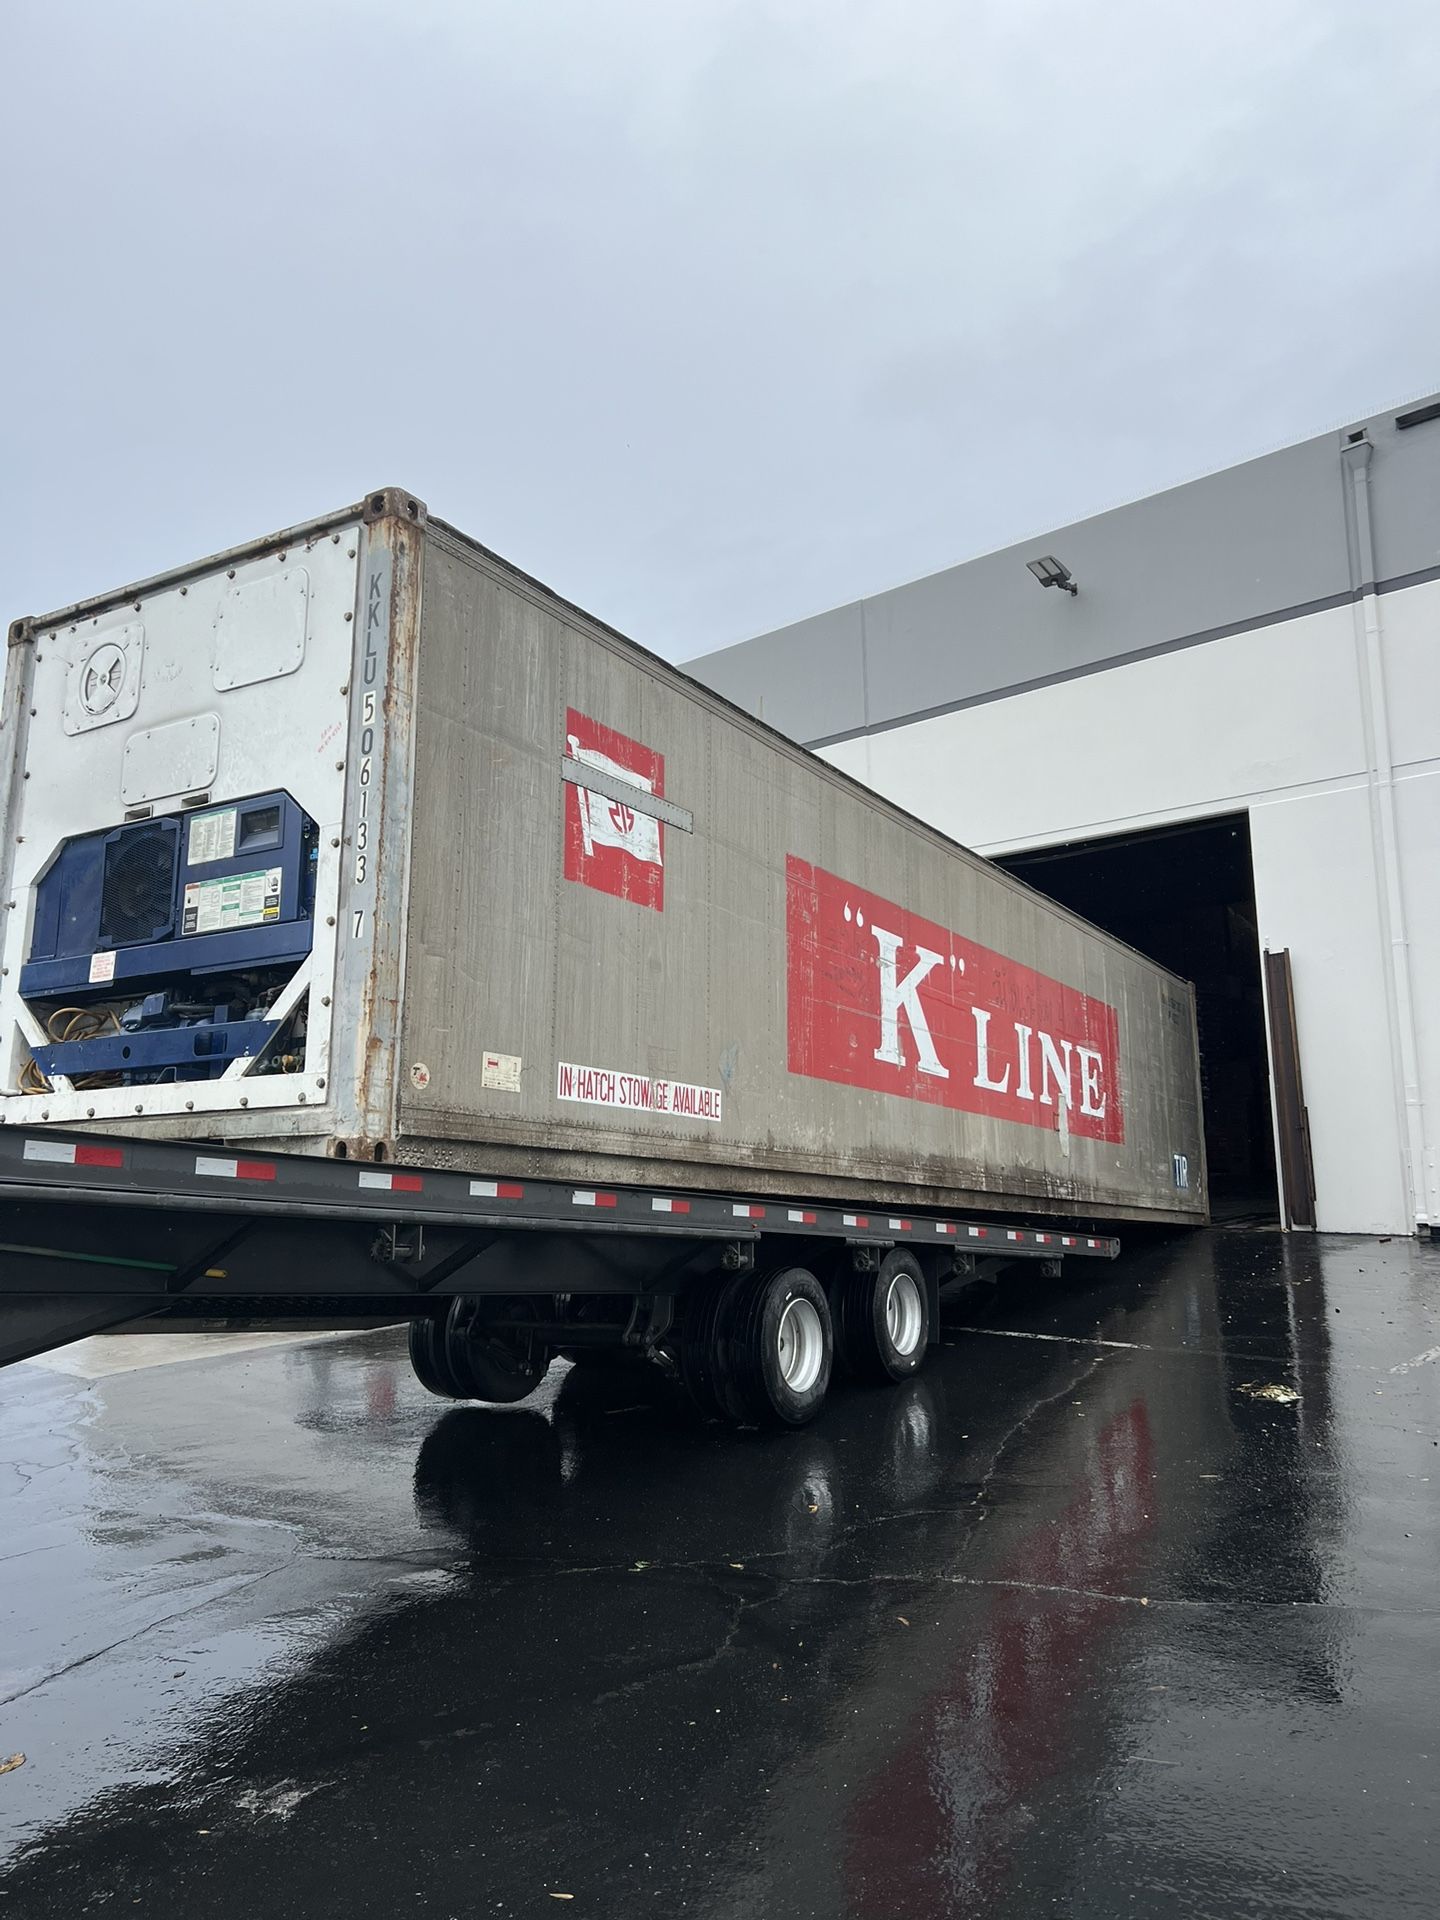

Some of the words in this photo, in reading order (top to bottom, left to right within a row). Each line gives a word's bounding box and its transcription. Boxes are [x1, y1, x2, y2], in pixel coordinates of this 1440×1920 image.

[363, 572, 382, 685] KKLU
[355, 692, 375, 884] 506133
[353, 910, 364, 939] 7
[559, 1066, 573, 1097] IN
[577, 1069, 616, 1103] HATCH
[672, 1085, 720, 1119] AVAILABLE
[971, 1006, 1107, 1119] LINE
[1173, 1154, 1189, 1188] TIR
